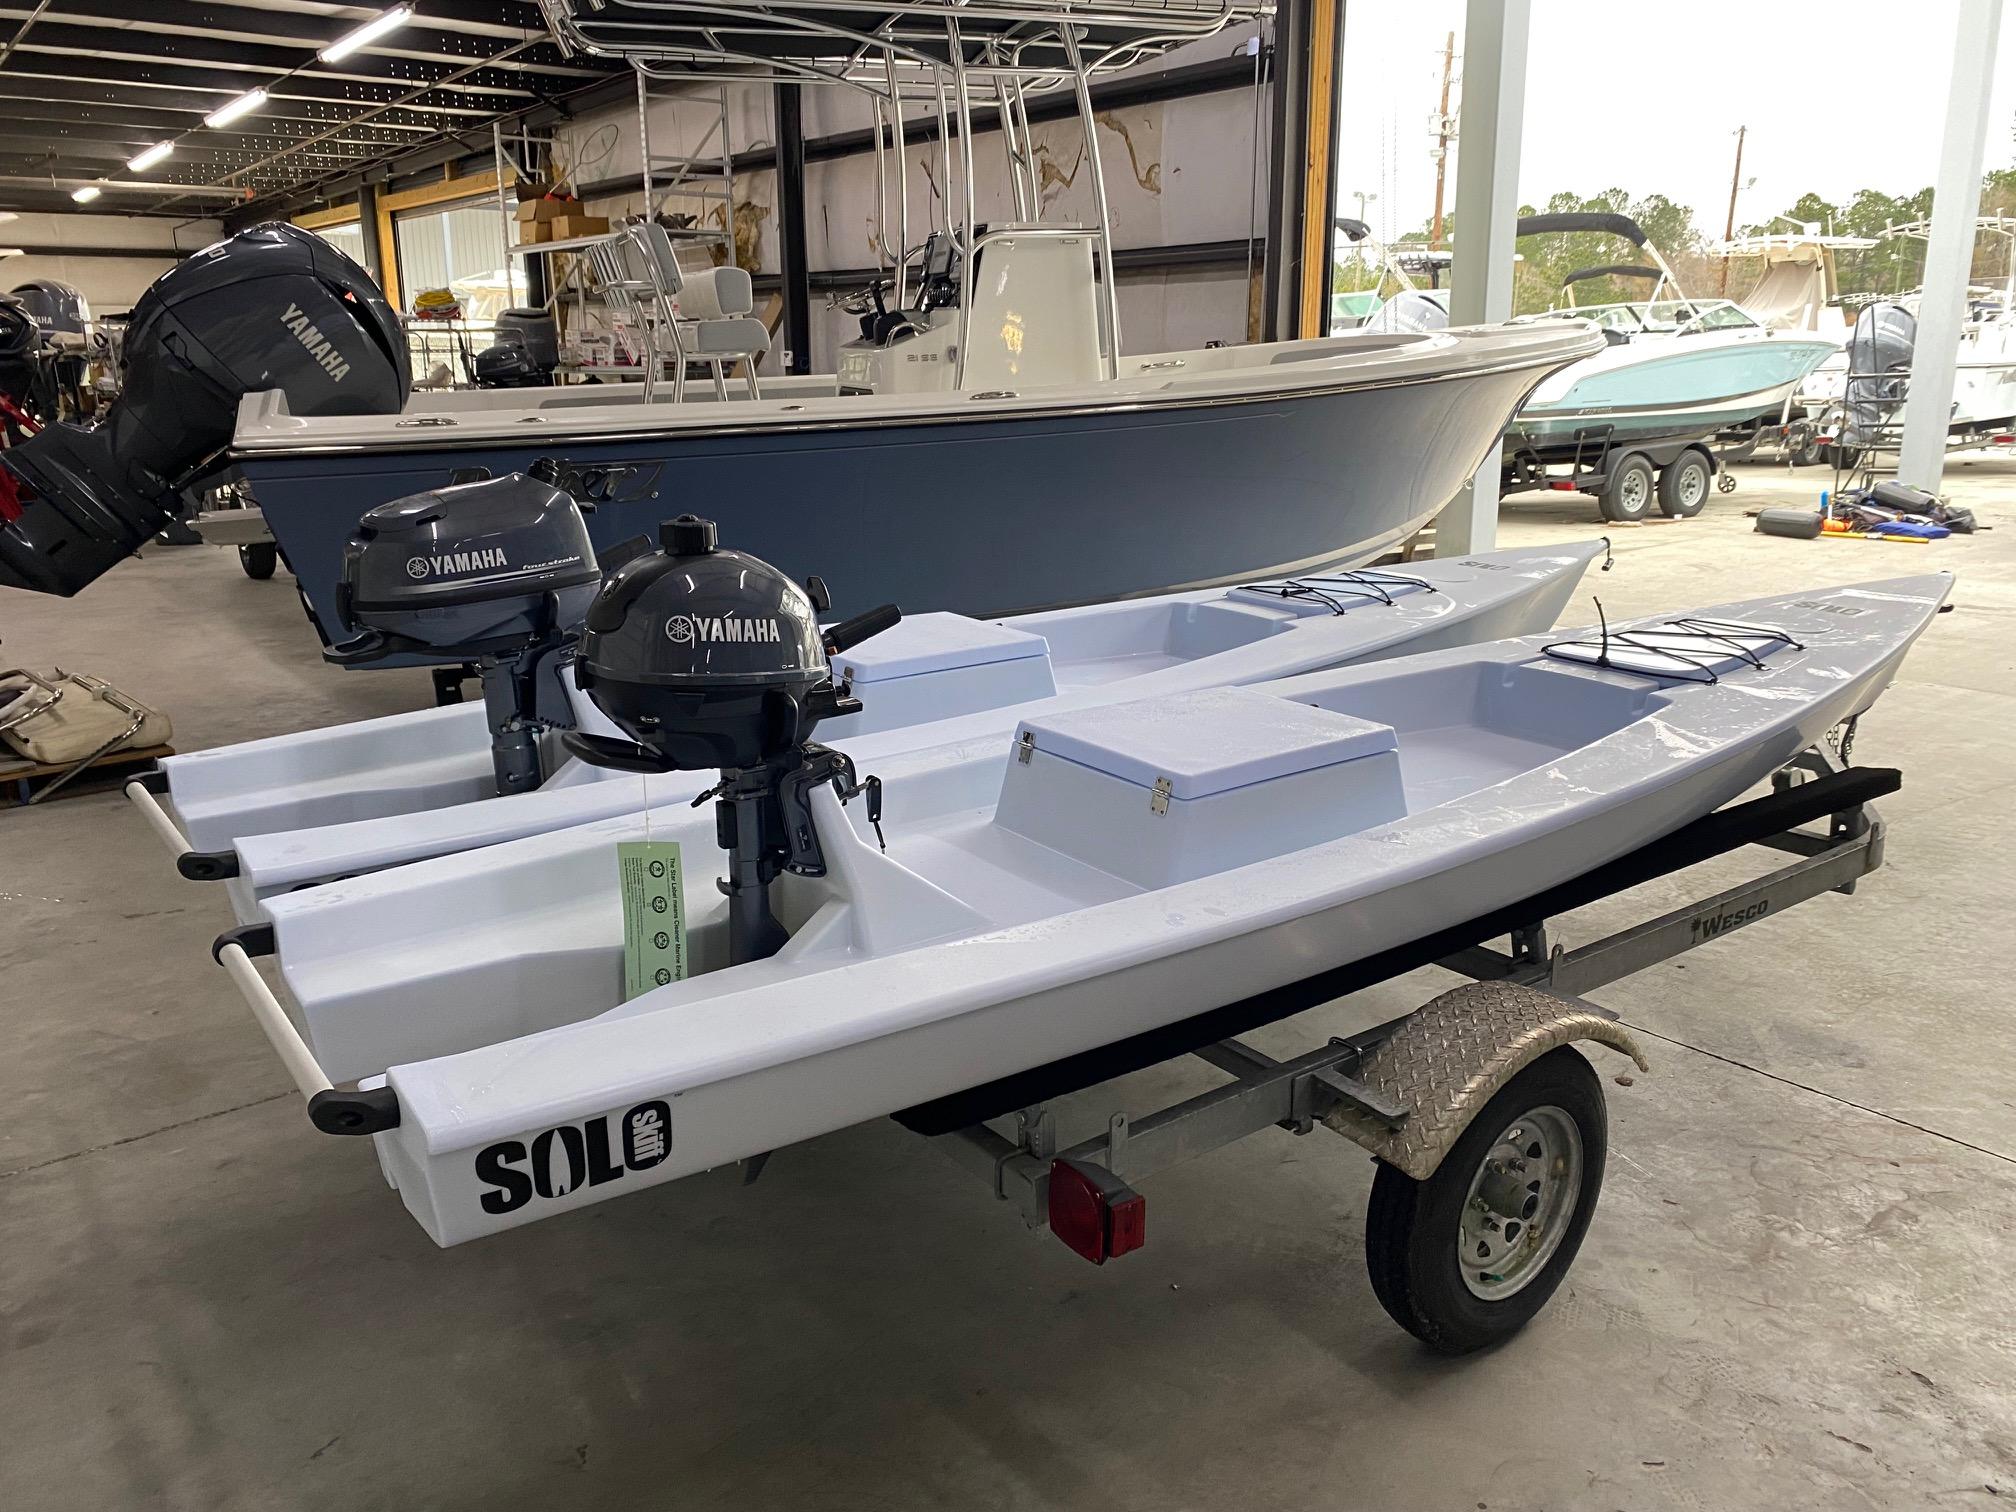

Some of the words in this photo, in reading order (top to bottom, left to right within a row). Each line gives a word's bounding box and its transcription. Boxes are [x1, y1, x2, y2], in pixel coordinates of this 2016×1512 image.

[280, 303, 351, 382] YAMAHA
[430, 547, 508, 576] YAMAHA
[694, 617, 781, 643] YAMAHA
[671, 882, 679, 899] Label
[474, 1100, 673, 1215] SOLO
